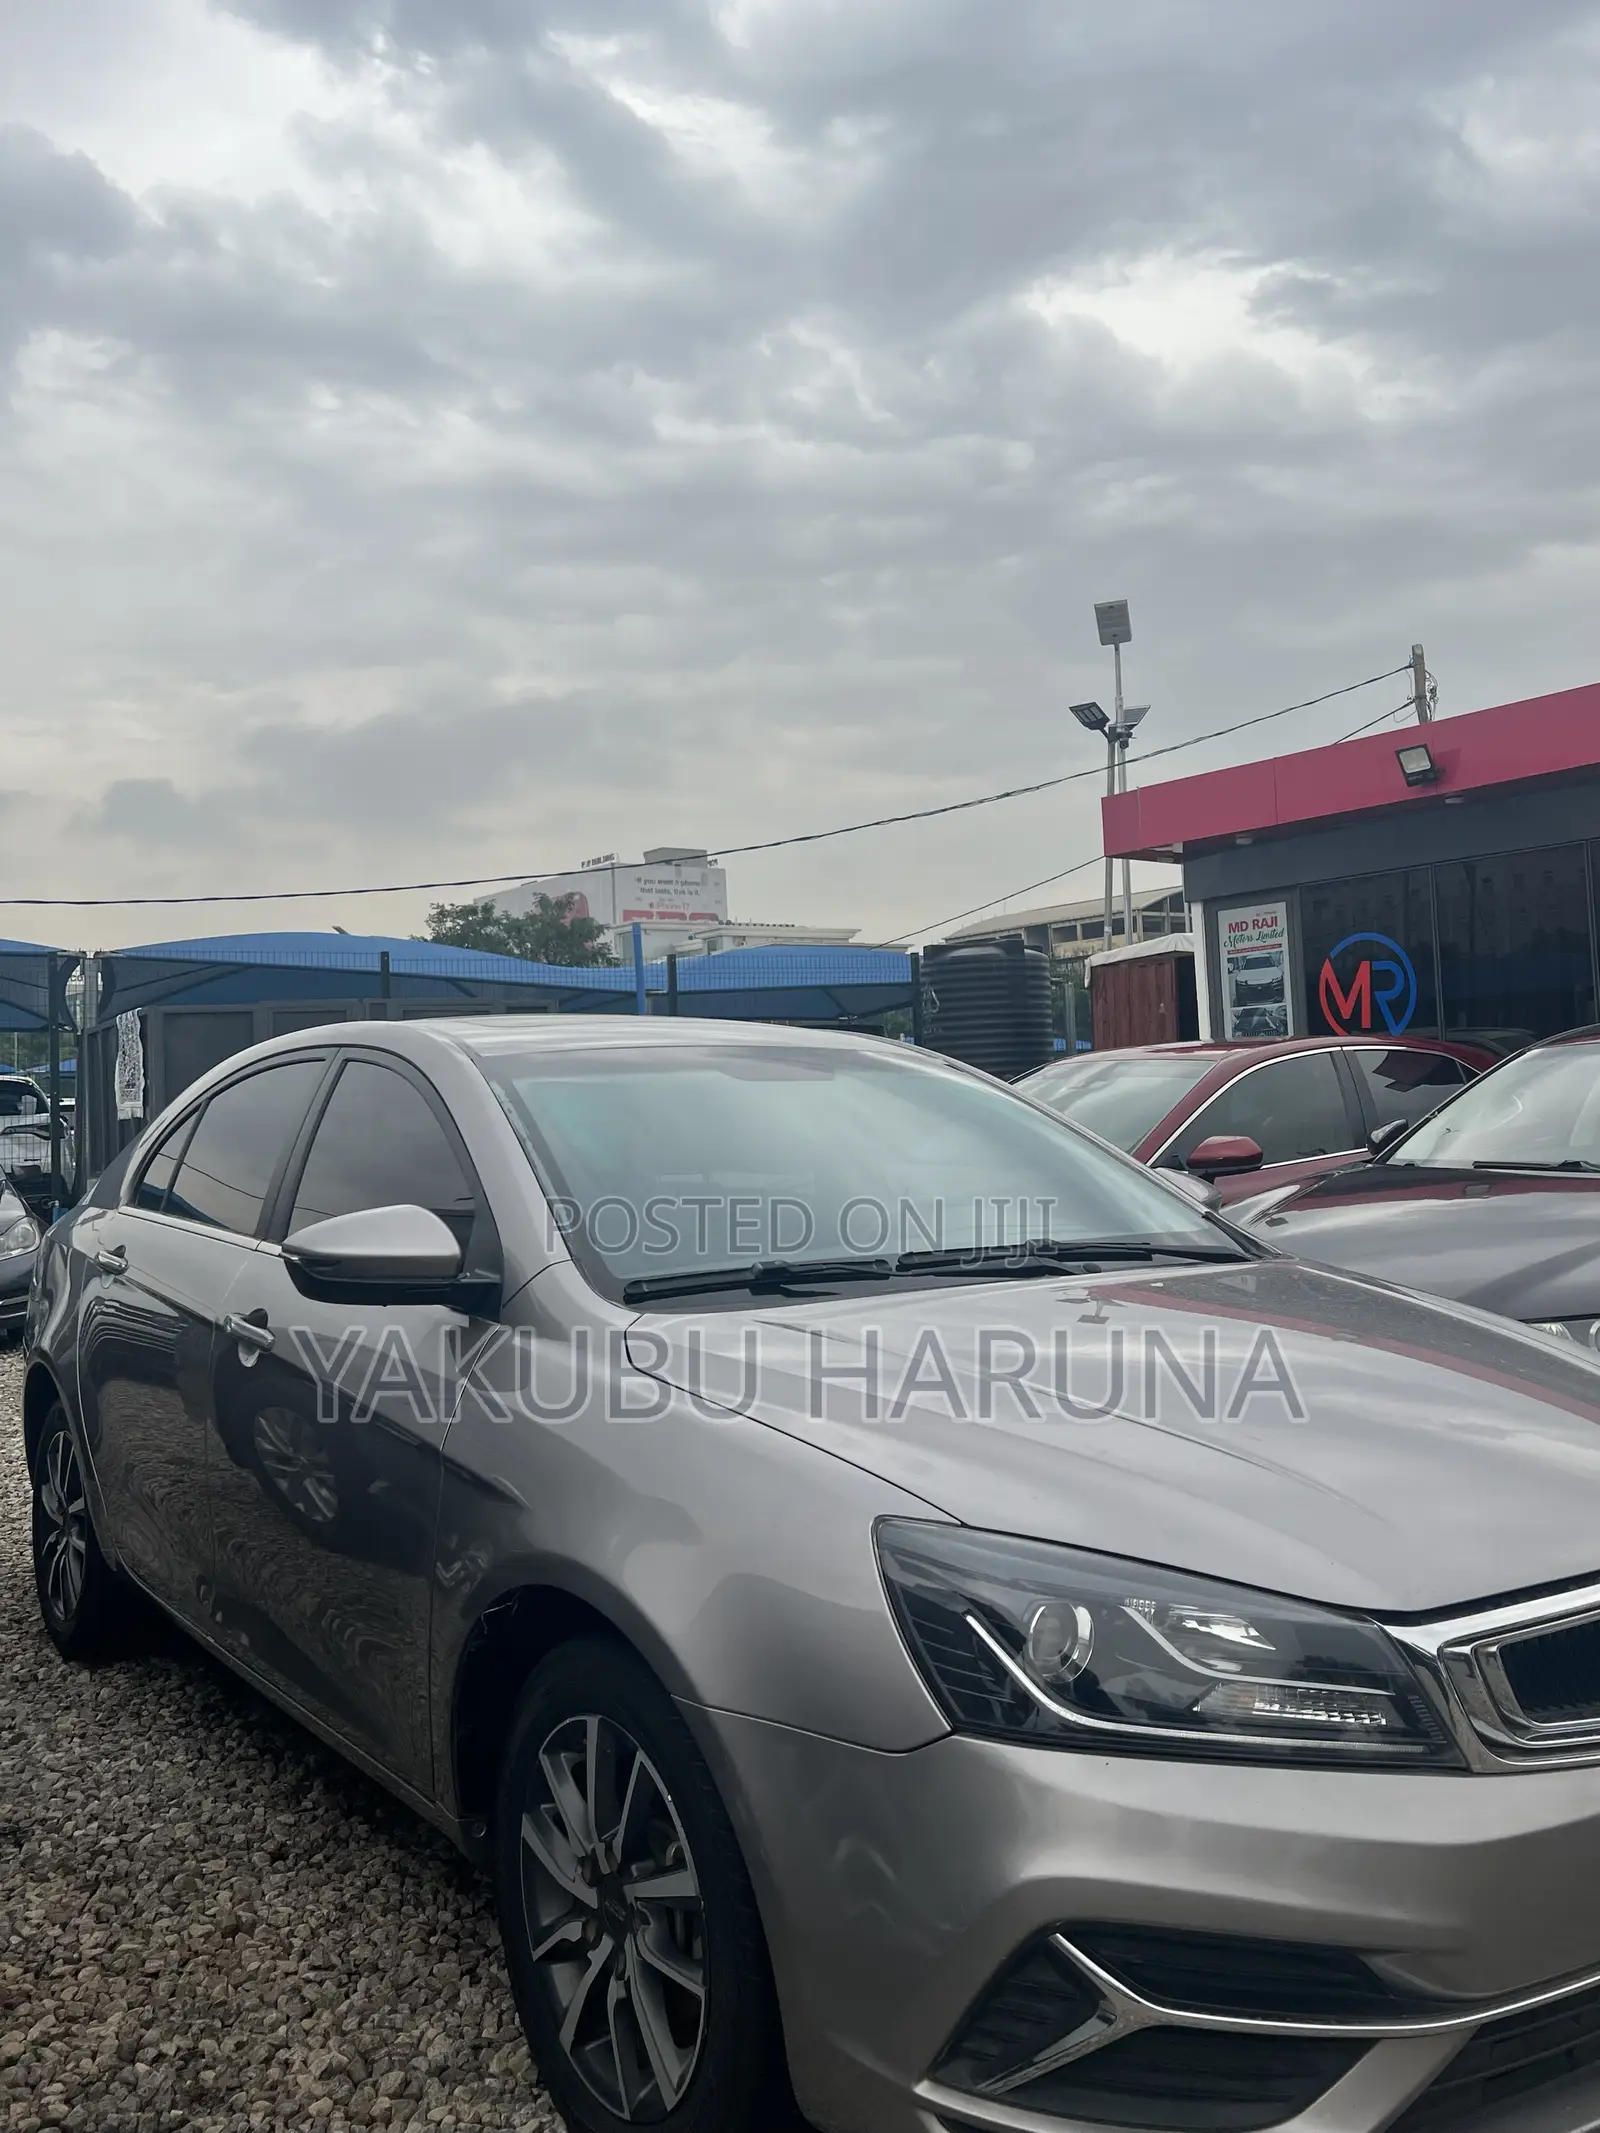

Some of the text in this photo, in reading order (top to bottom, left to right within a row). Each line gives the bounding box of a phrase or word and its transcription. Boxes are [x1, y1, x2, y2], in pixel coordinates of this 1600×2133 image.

[680, 879, 700, 887] phone
[1228, 915, 1278, 934] MD RAJI
[1223, 934, 1253, 949] Motors
[1256, 927, 1284, 943] Limited
